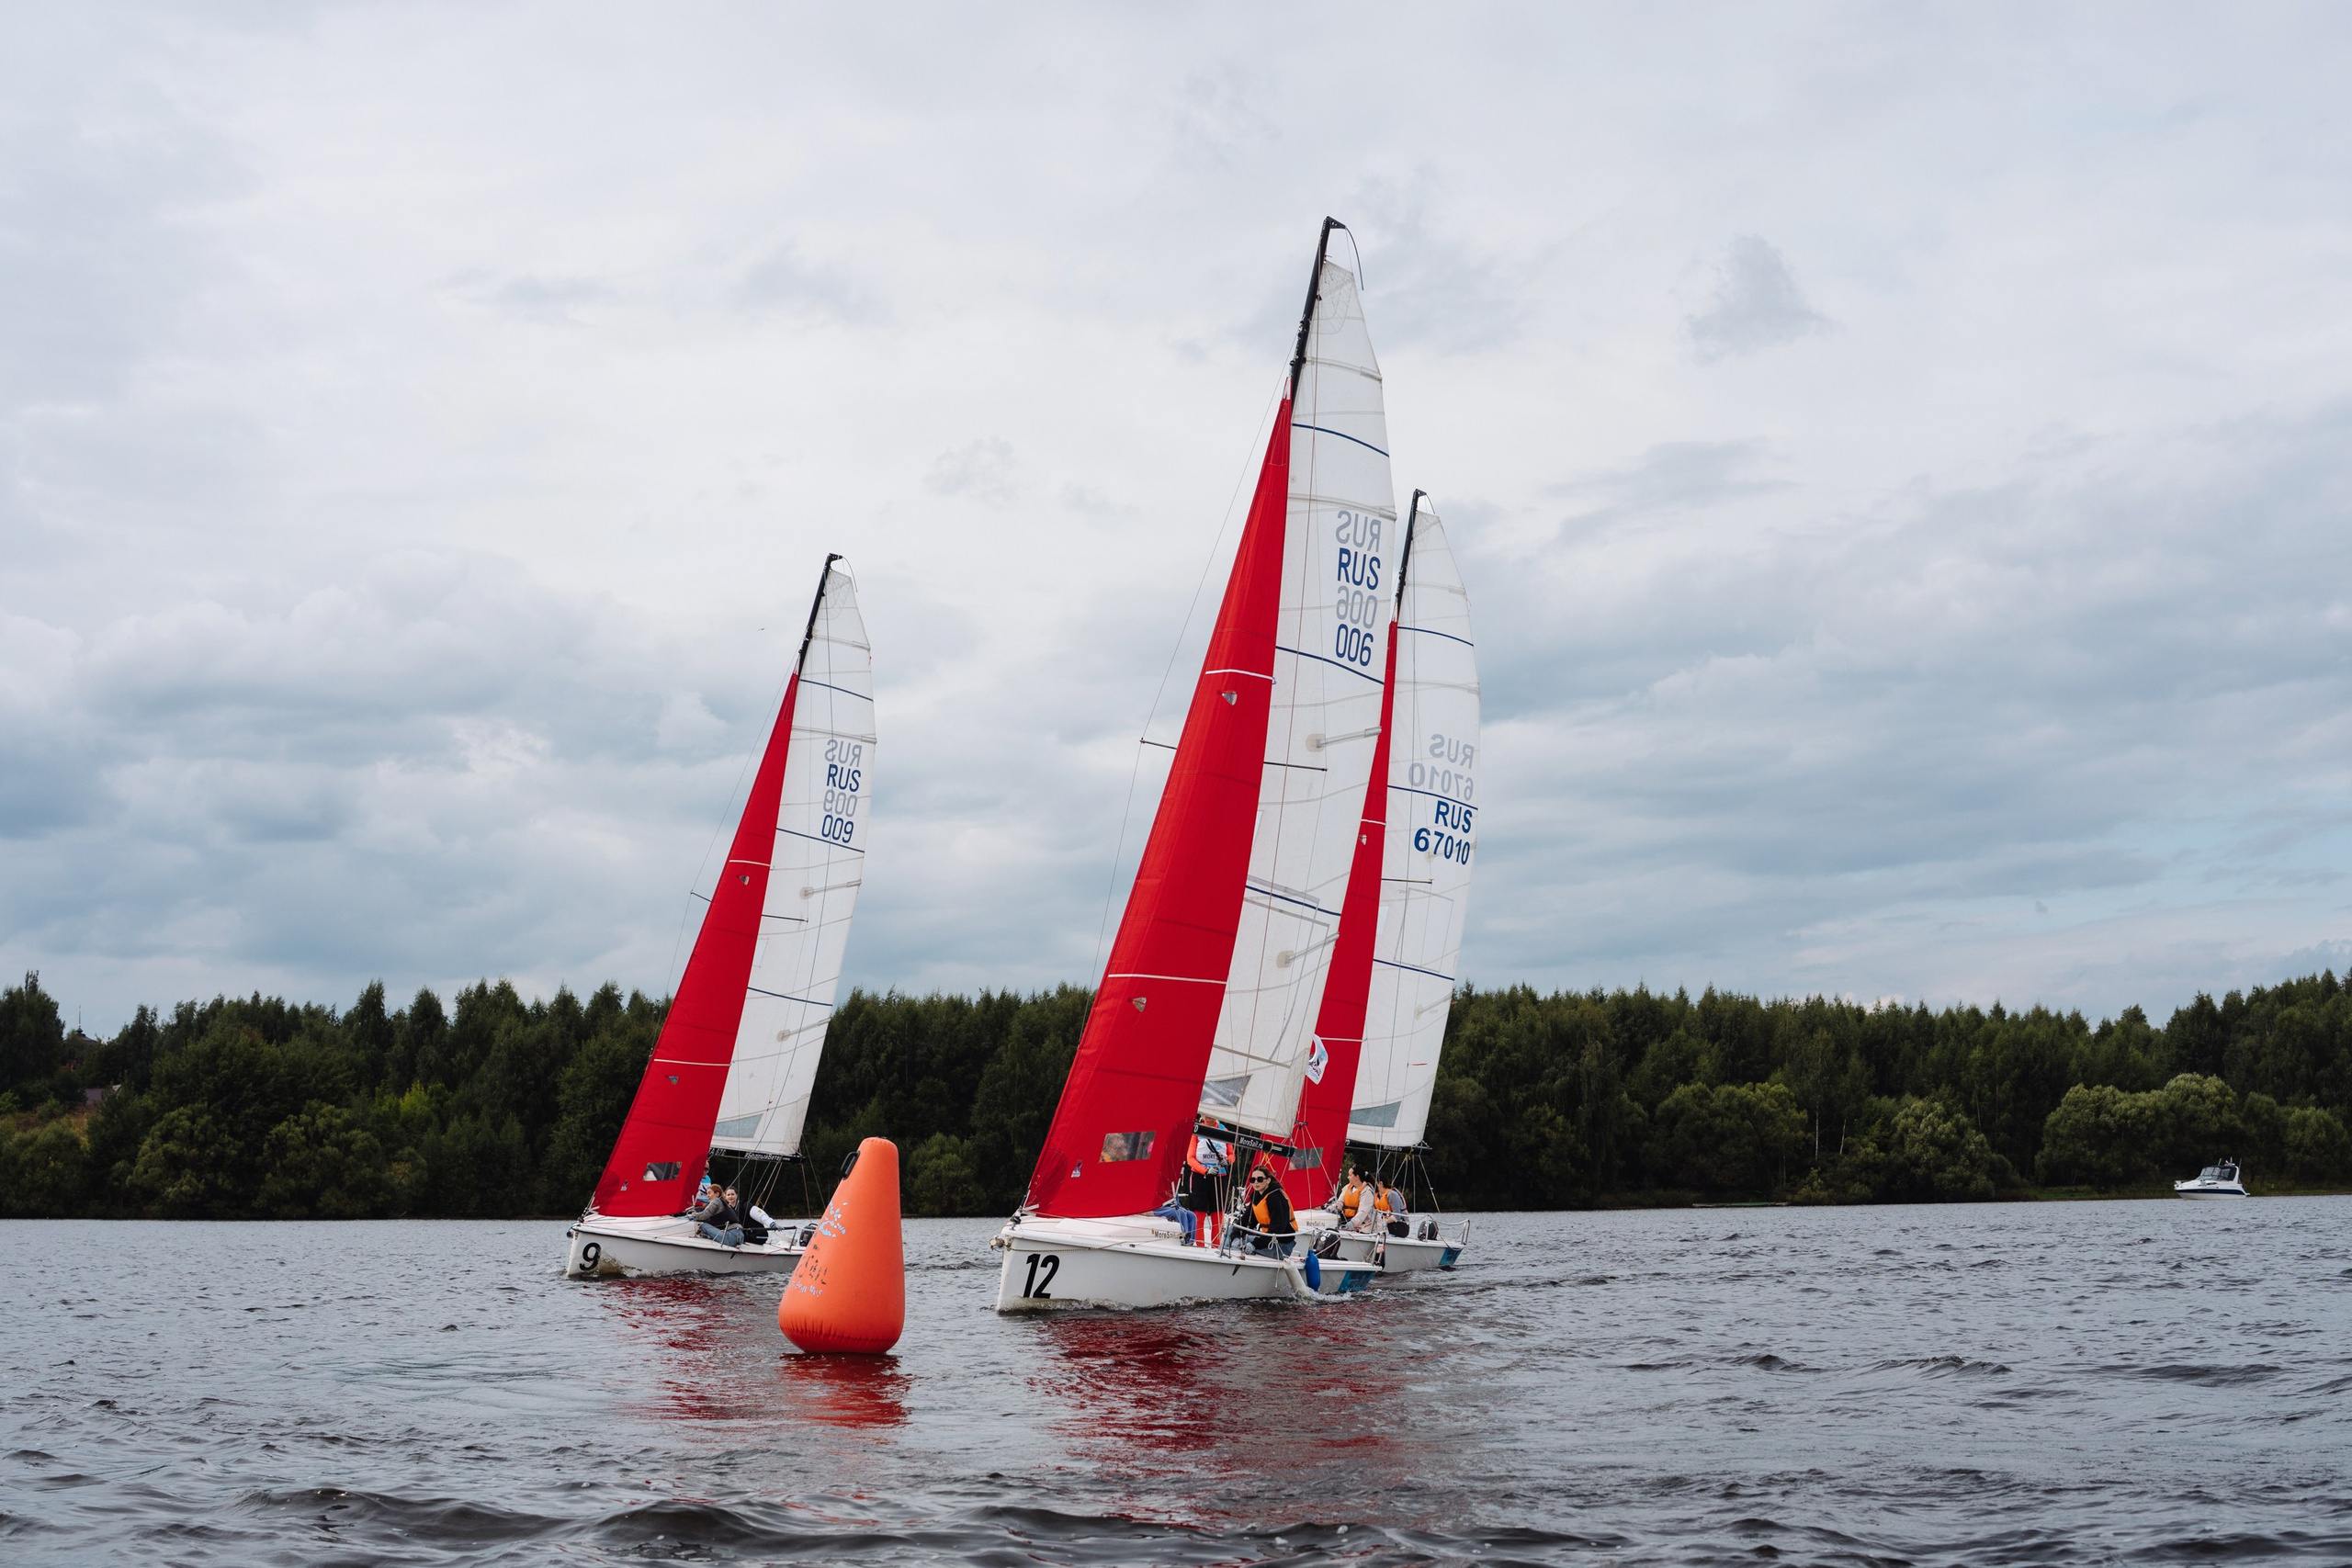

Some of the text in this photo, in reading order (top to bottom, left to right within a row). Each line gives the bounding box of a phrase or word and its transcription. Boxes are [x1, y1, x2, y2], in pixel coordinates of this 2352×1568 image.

[1337, 547, 1381, 590] RUS
[1336, 624, 1374, 666] 006
[826, 764, 862, 792] RUS
[821, 815, 854, 843] 009
[1434, 800, 1473, 834] RUS
[1414, 828, 1471, 865] 67010
[579, 1242, 602, 1271] 9
[1023, 1254, 1060, 1299] 12
